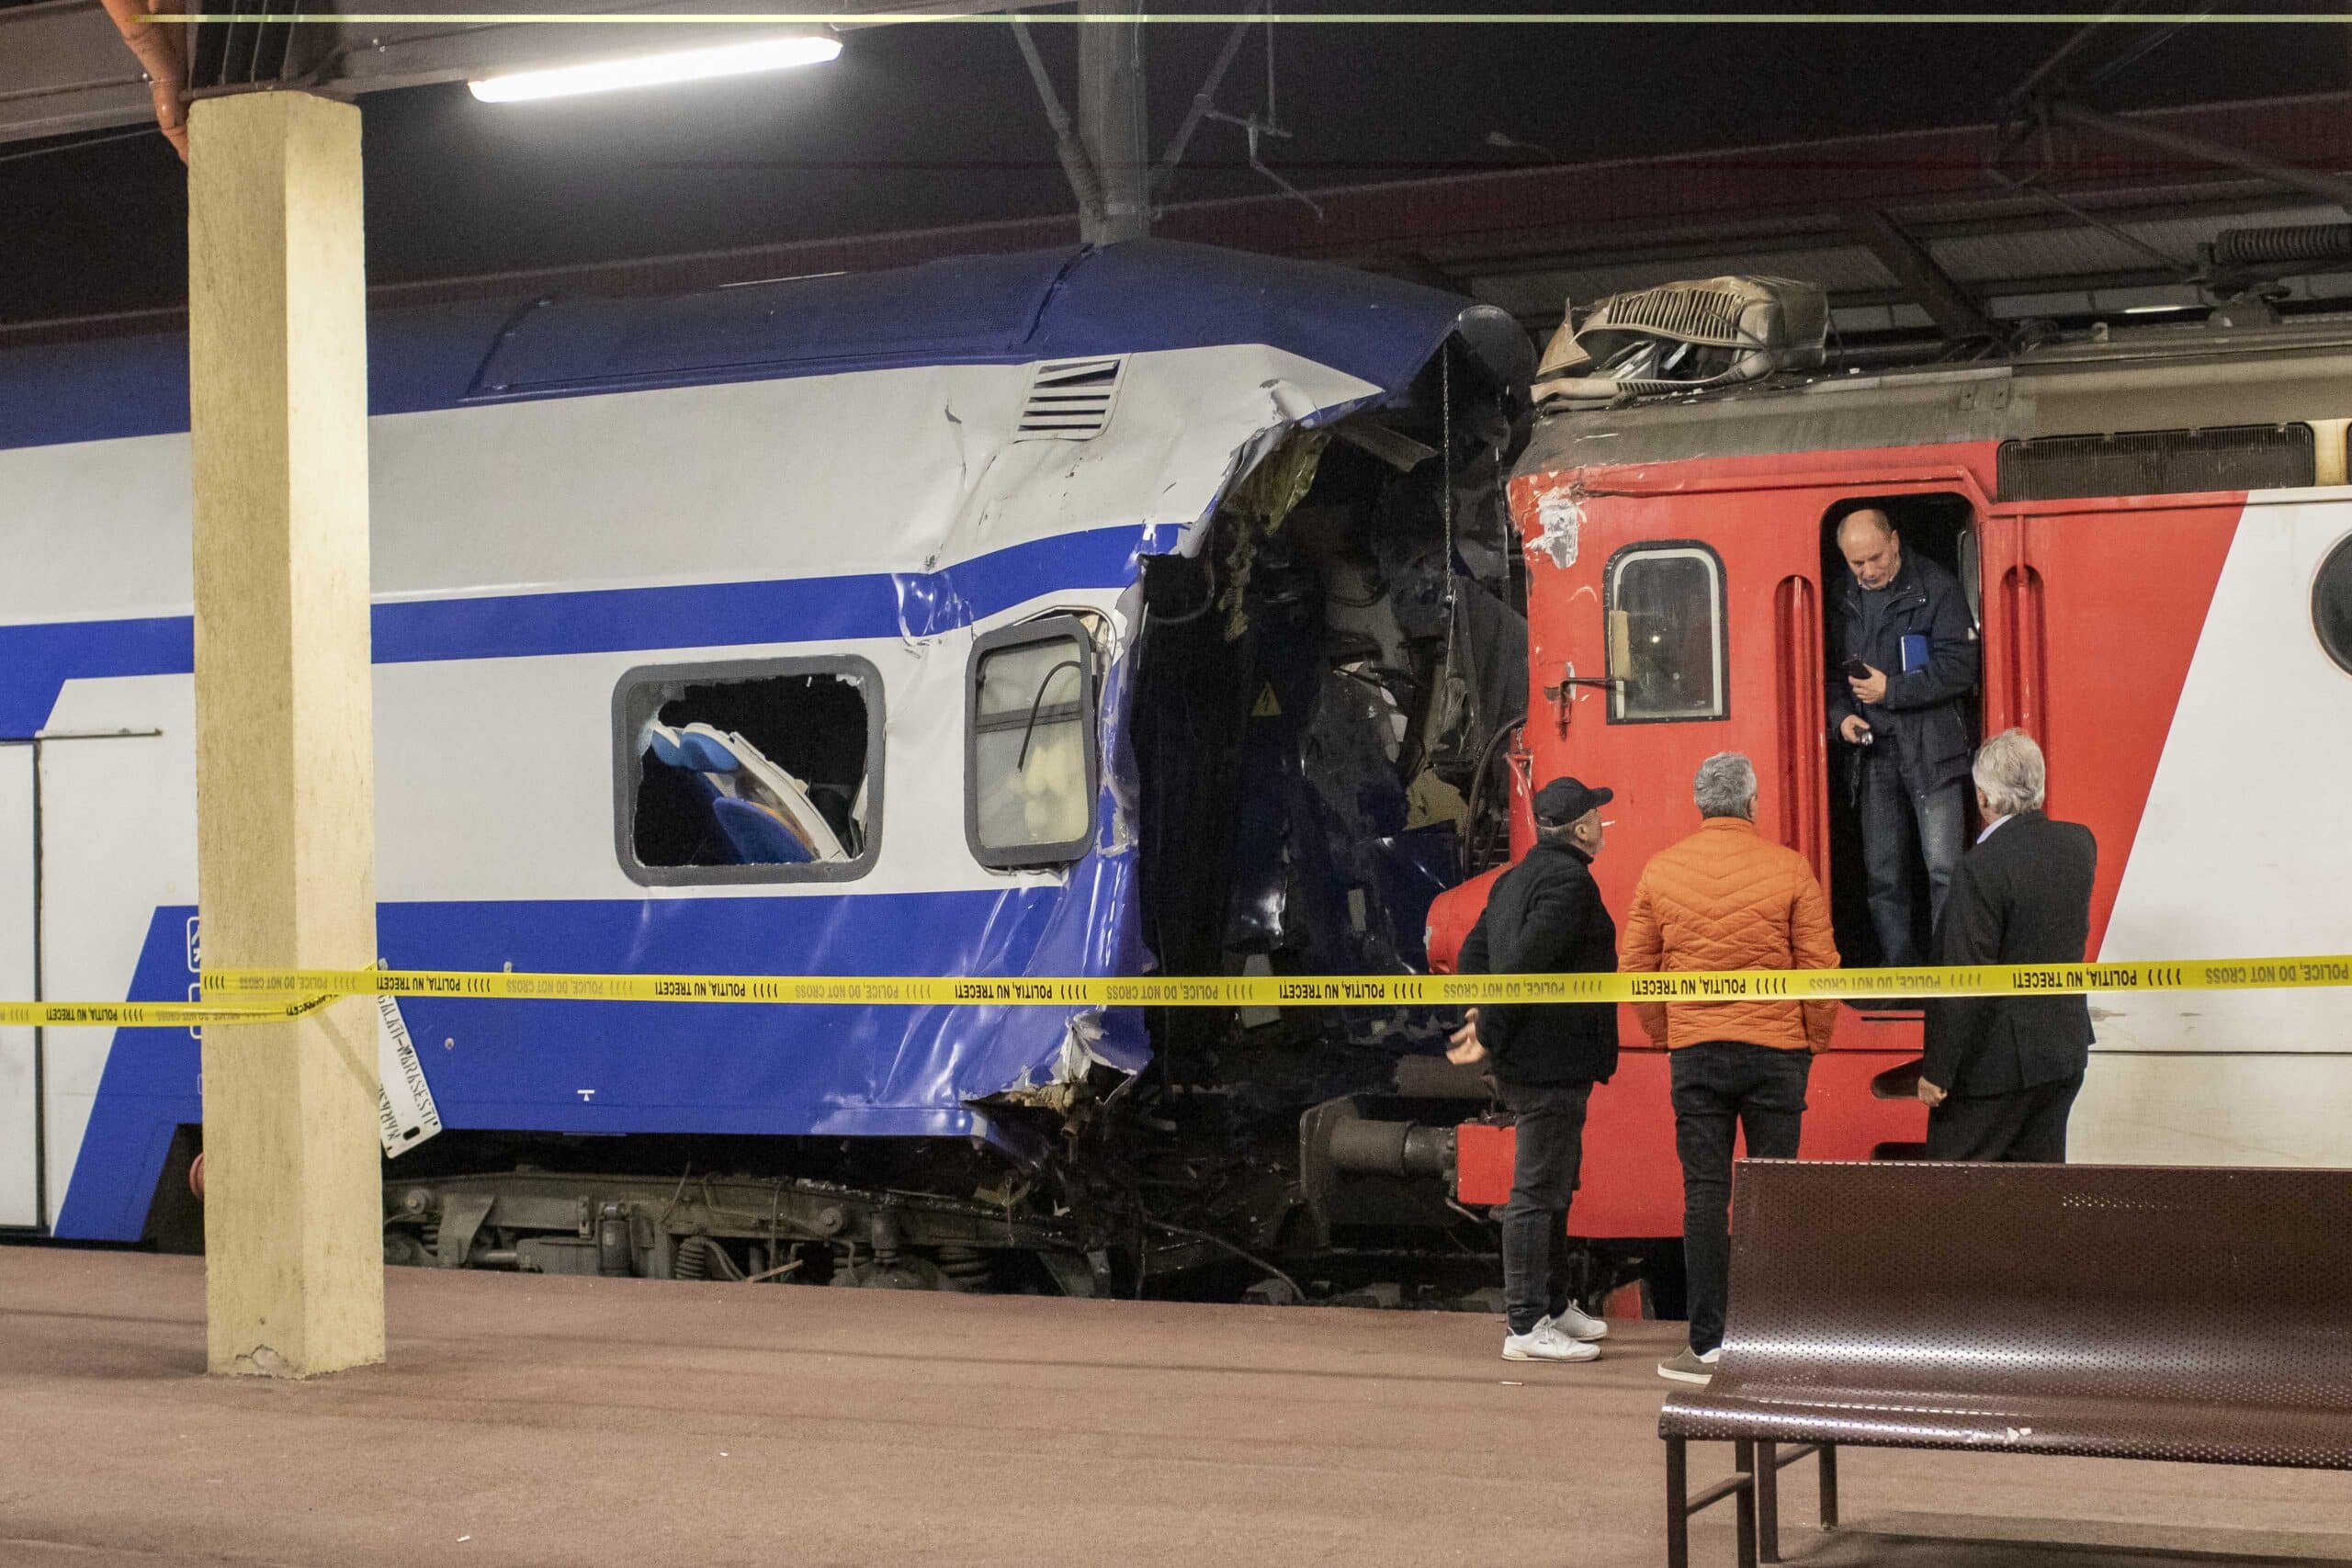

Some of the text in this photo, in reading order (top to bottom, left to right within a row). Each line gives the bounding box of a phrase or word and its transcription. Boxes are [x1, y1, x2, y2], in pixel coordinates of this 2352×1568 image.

[2067, 972, 2083, 987] NU
[2206, 966, 2245, 984] CROSS
[2251, 965, 2275, 982] NOT
[2279, 965, 2296, 981] DO
[413, 977, 424, 990] NU
[507, 980, 533, 993] CROSS
[537, 981, 553, 993] NOT
[557, 981, 568, 993] DO
[695, 983, 706, 995] NU
[1681, 979, 1696, 994] NU
[796, 985, 824, 998] CROSS
[828, 985, 845, 998] NOT
[849, 985, 860, 998] DO
[997, 985, 1010, 998] NU
[1106, 986, 1137, 999] CROSS
[1141, 986, 1160, 999] NOT
[1164, 986, 1176, 999] DO
[1325, 985, 1339, 998] NU
[1444, 983, 1477, 998] CROSS
[1483, 983, 1502, 998] NOT
[1507, 983, 1520, 998] DO
[77, 1010, 86, 1021] NU
